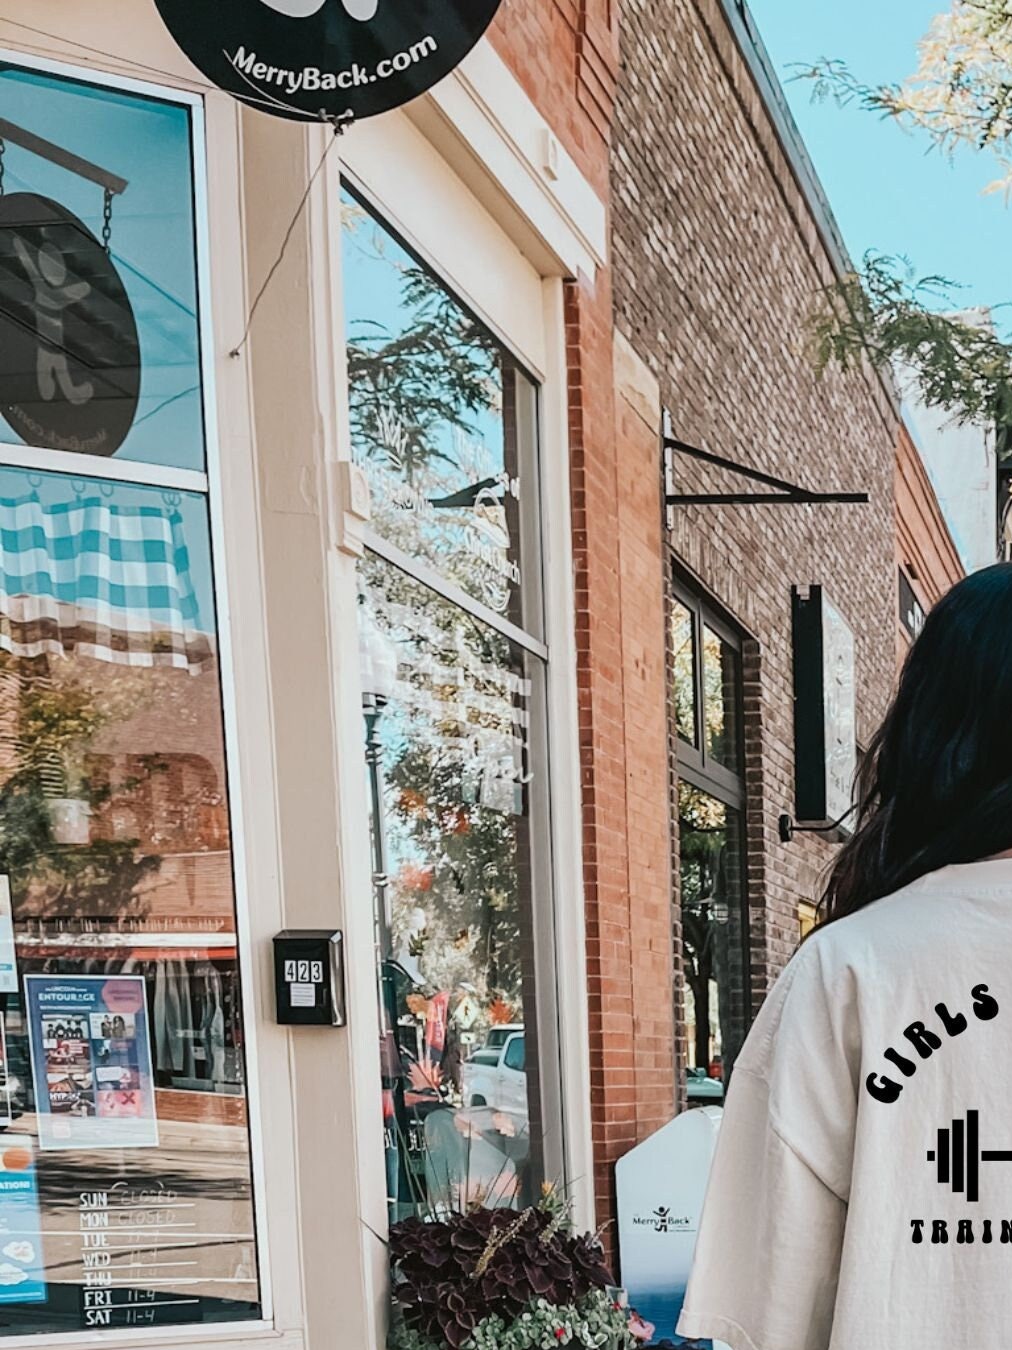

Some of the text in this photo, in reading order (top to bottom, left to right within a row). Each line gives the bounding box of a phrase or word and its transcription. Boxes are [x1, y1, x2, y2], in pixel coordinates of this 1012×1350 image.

[232, 36, 438, 95] MerryBack.com
[286, 961, 321, 981] 423
[866, 984, 999, 1104] GIRLS
[80, 1190, 178, 1207] SUN CLOSED
[80, 1211, 176, 1227] MON CLOSED
[633, 1216, 690, 1226] Merry Back
[82, 1233, 110, 1247] TUE
[82, 1251, 111, 1267] WED
[83, 1271, 112, 1287] THU
[84, 1290, 156, 1306] FRI 11-4
[85, 1309, 155, 1325] SAT 11-4
